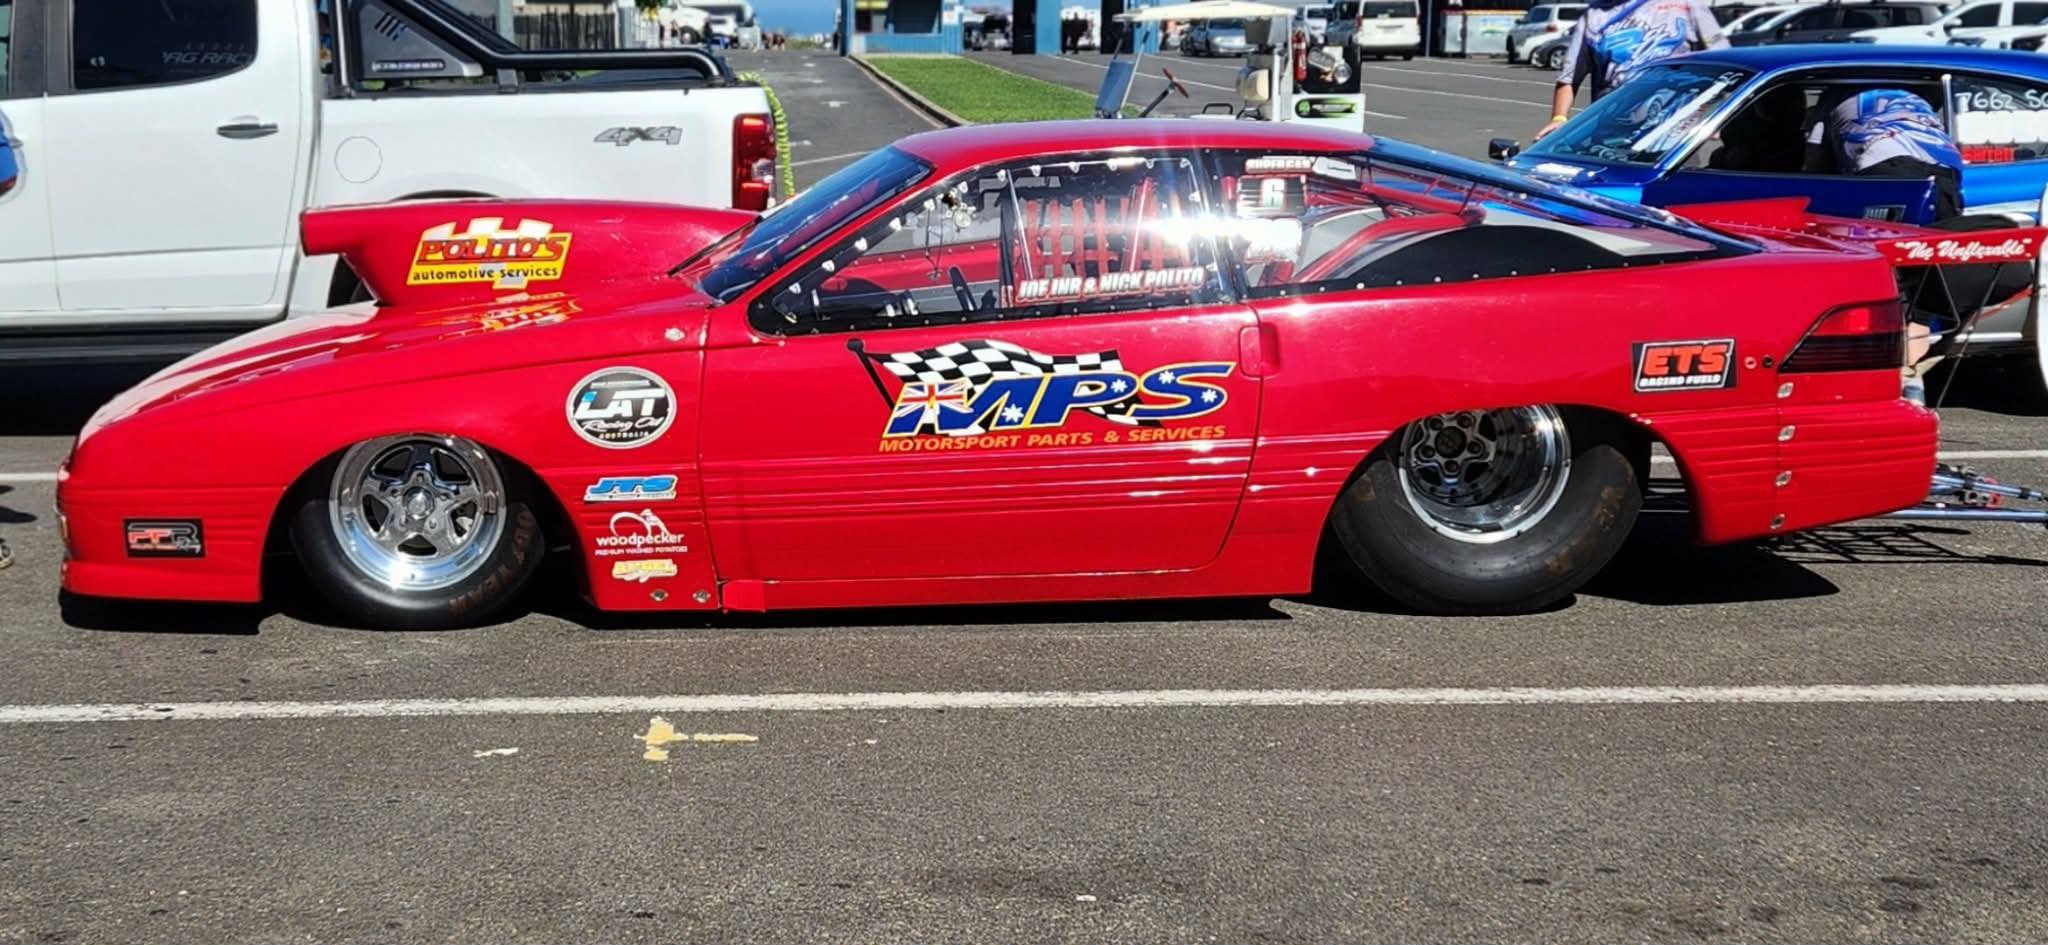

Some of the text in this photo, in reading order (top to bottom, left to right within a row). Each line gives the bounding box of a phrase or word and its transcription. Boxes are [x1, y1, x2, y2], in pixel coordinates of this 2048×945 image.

[1954, 91, 2018, 112] 7662
[417, 236, 568, 264] POLITO'S
[412, 264, 559, 281] automotive services
[1084, 277, 1098, 295] &
[1099, 271, 1145, 292] NICK
[1145, 266, 1206, 289] POLITO
[1643, 344, 1729, 376] ETS
[574, 388, 667, 420] LAT
[882, 361, 1237, 439] MPS
[580, 419, 634, 433] Racing
[878, 425, 1226, 453] MOTORSPORT PARTS & SERVICES
[595, 532, 685, 549] woodpecker
